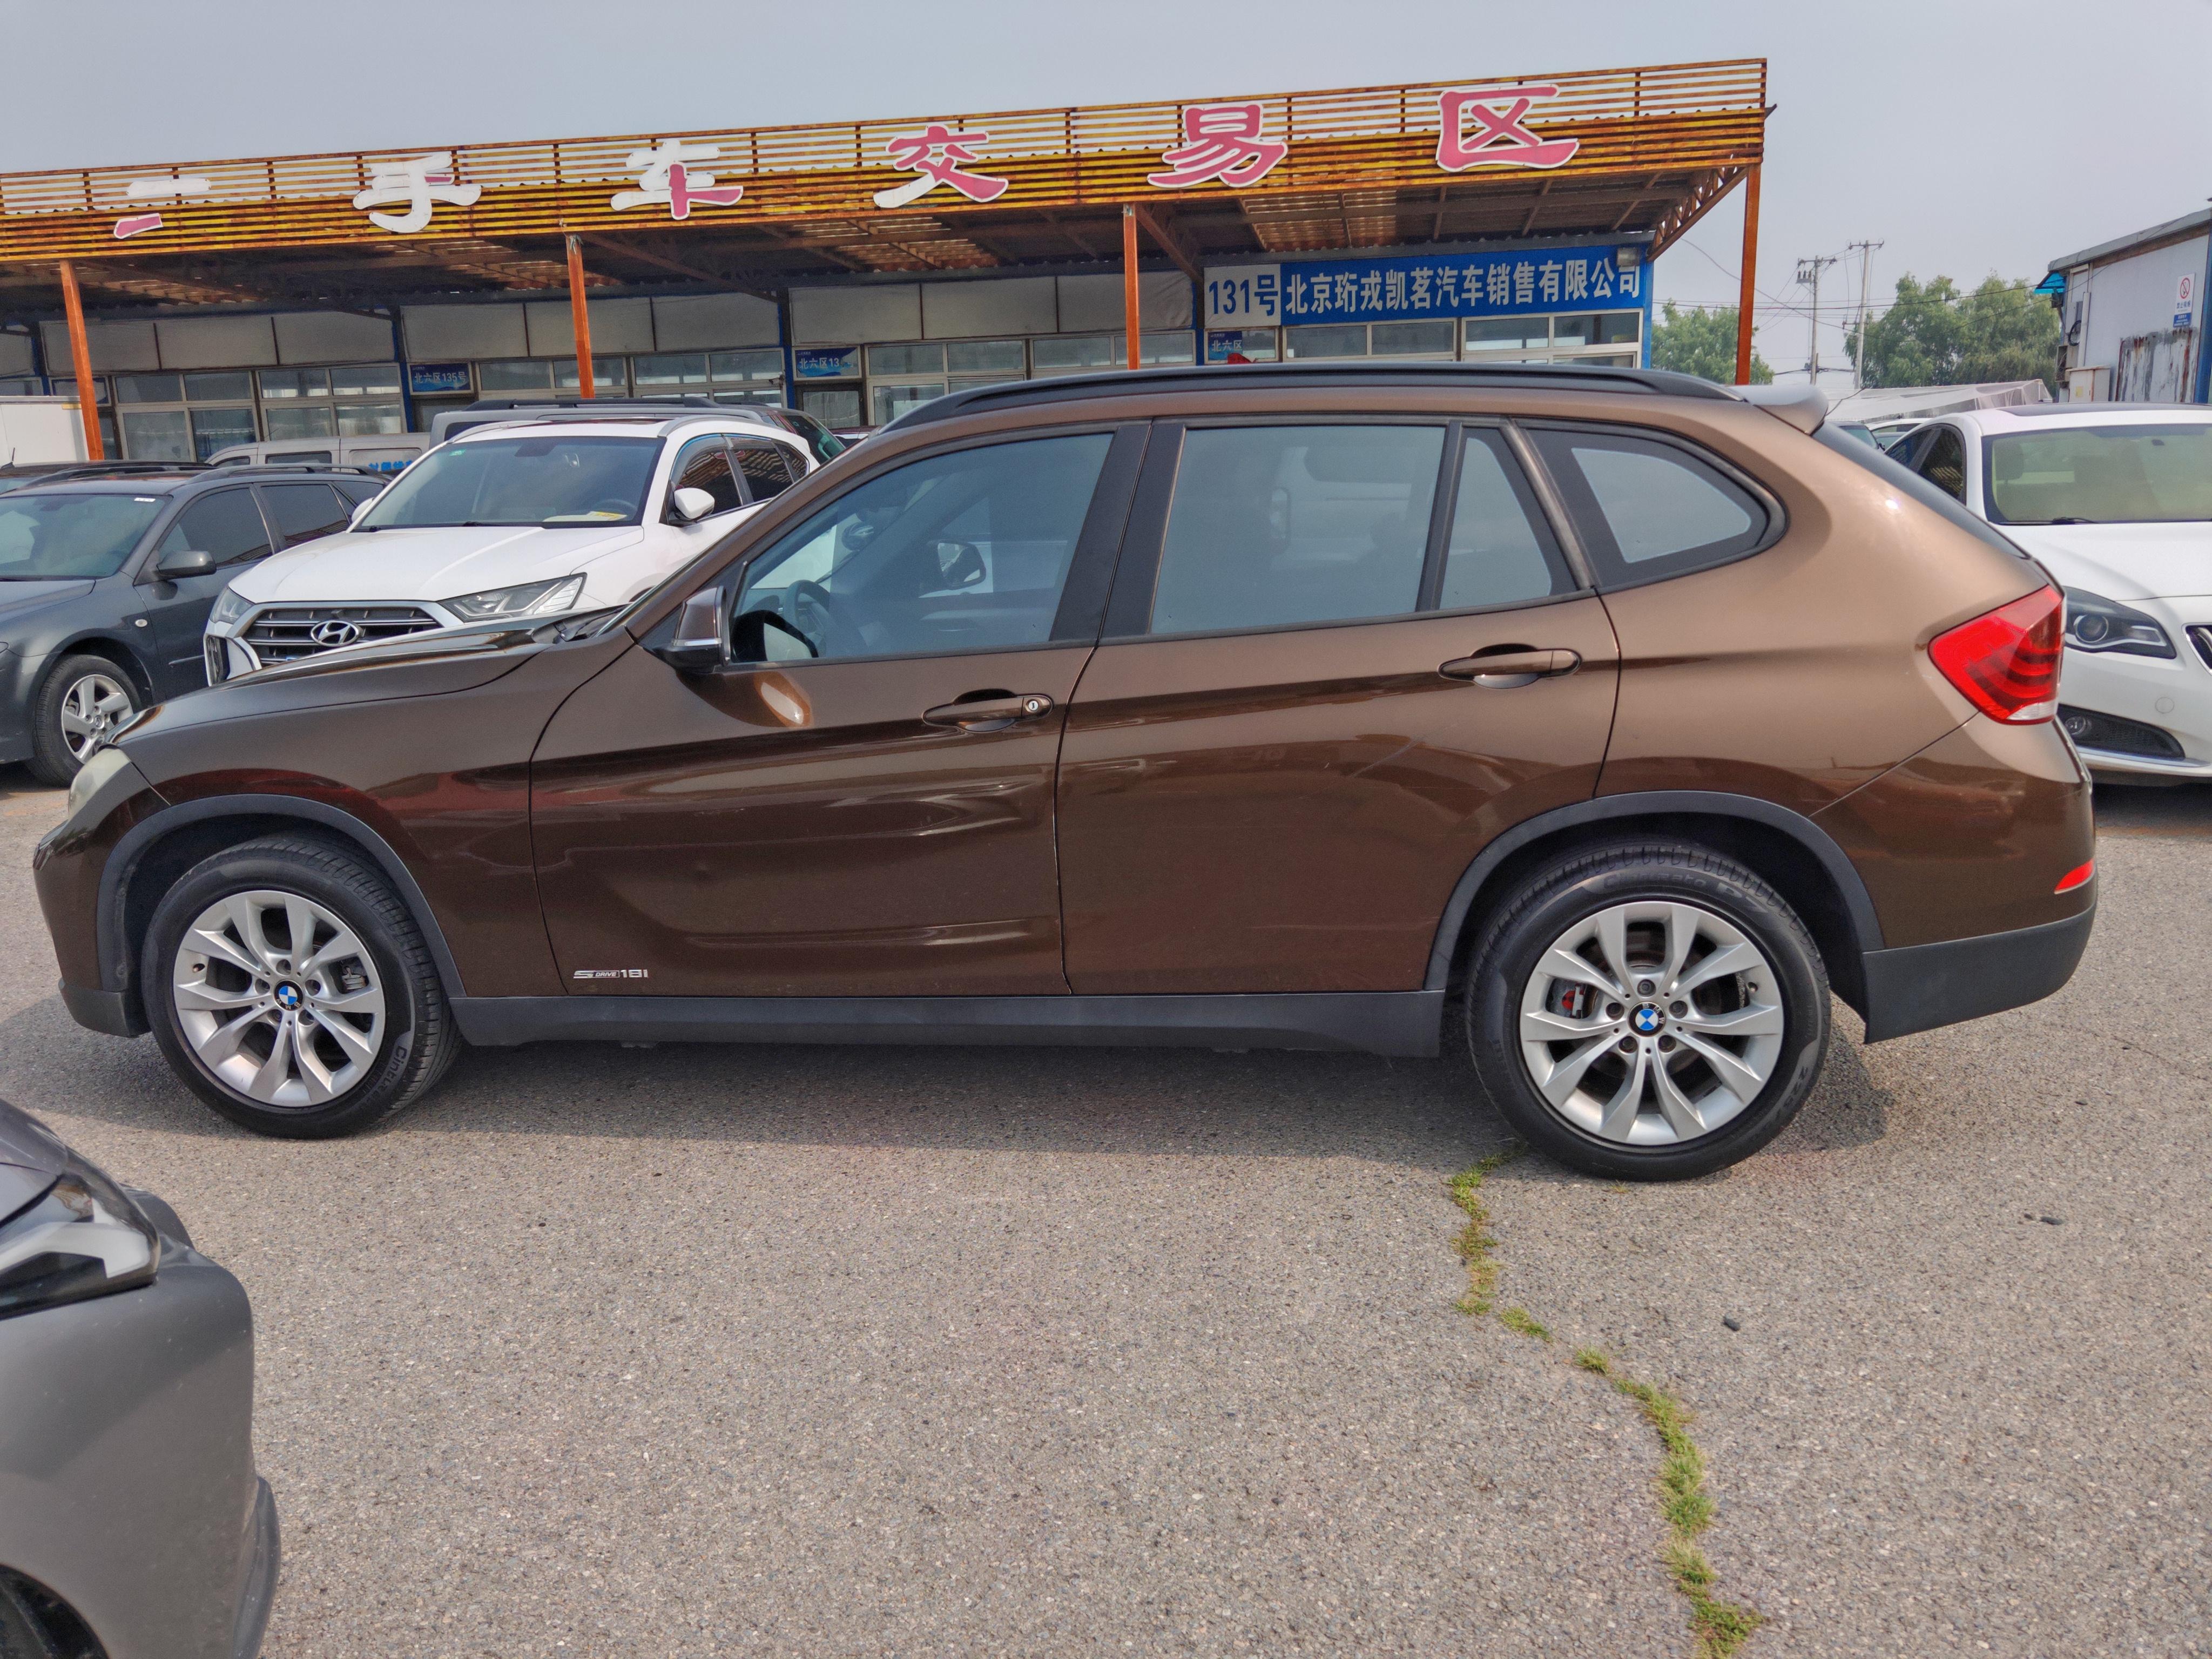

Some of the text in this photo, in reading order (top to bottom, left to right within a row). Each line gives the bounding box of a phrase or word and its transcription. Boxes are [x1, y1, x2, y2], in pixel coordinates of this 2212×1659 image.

[1209, 274, 1278, 316] 131号
[414, 371, 467, 384] 北六区135号
